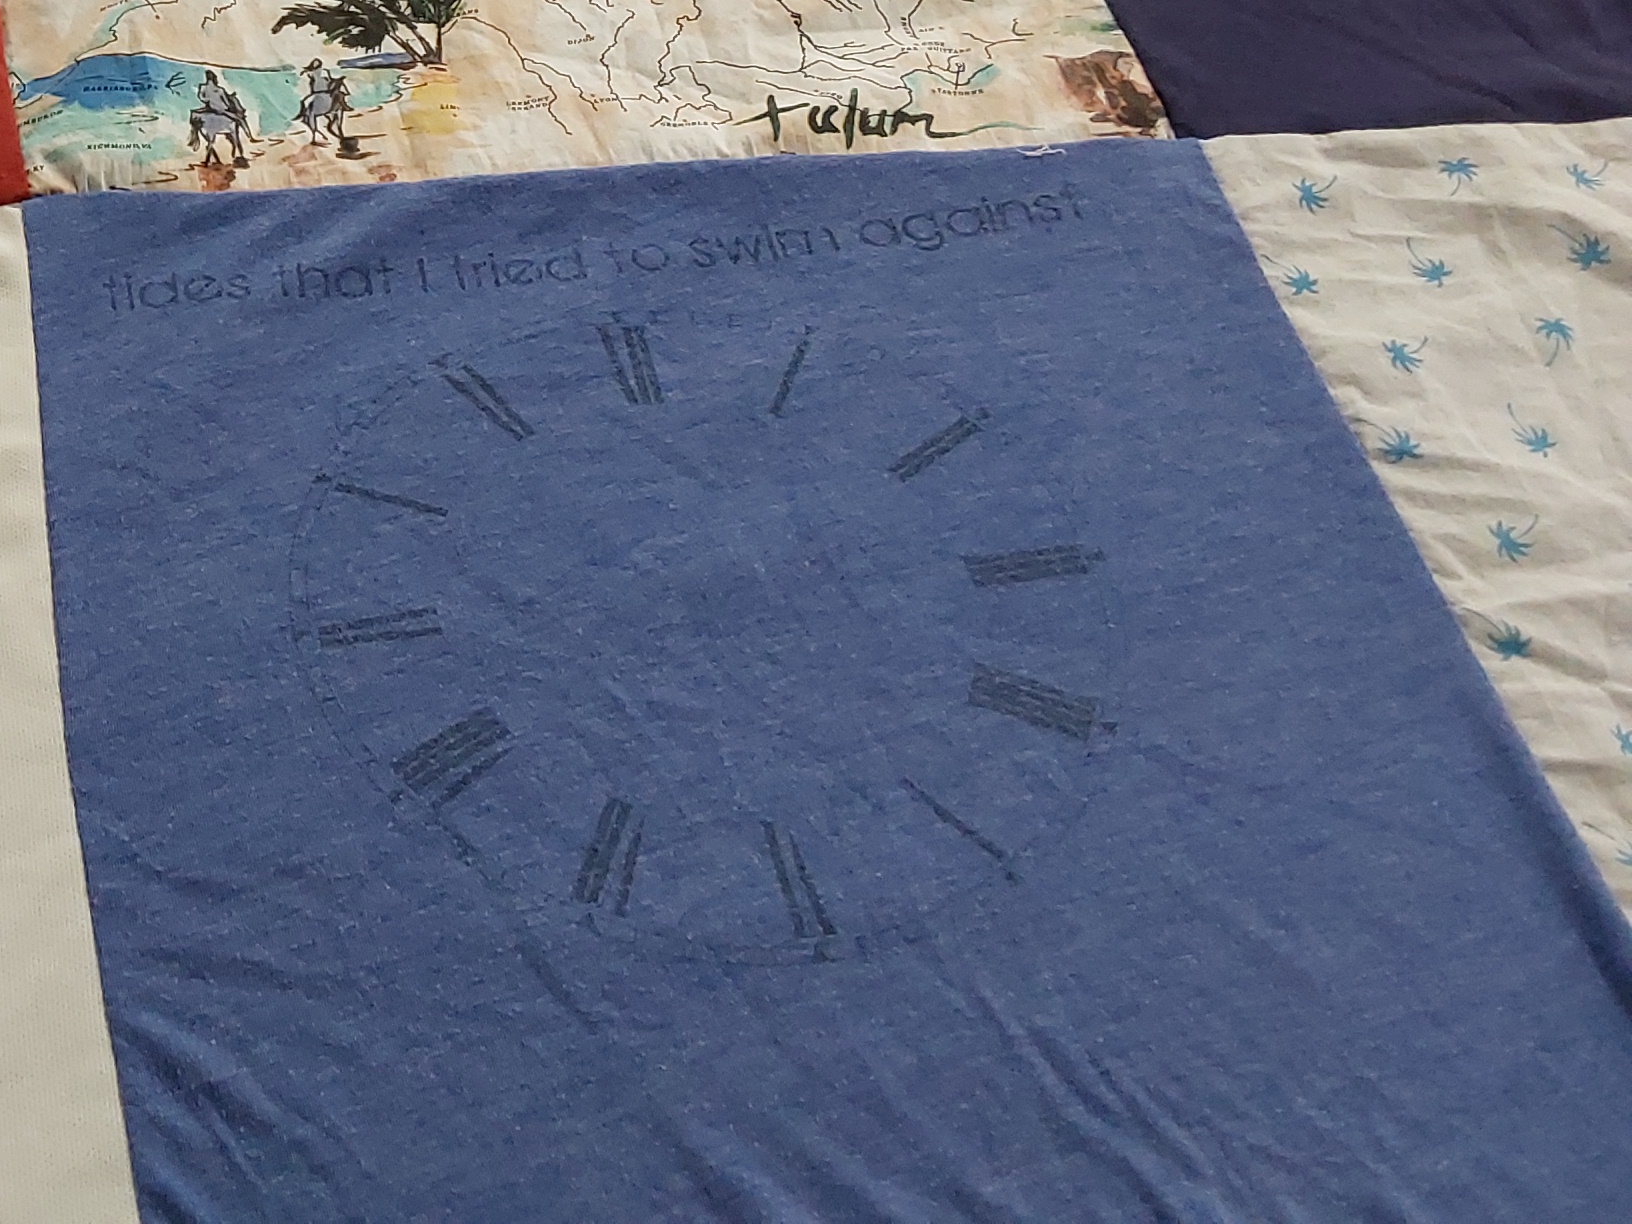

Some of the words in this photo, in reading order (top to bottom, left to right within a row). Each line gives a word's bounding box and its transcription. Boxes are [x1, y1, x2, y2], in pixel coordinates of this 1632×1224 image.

[102, 273, 252, 312] tides
[277, 256, 396, 300] that
[417, 256, 431, 293] I
[454, 250, 589, 292] tried
[603, 240, 669, 274] to
[687, 227, 843, 268] swim
[859, 183, 1090, 252] against
